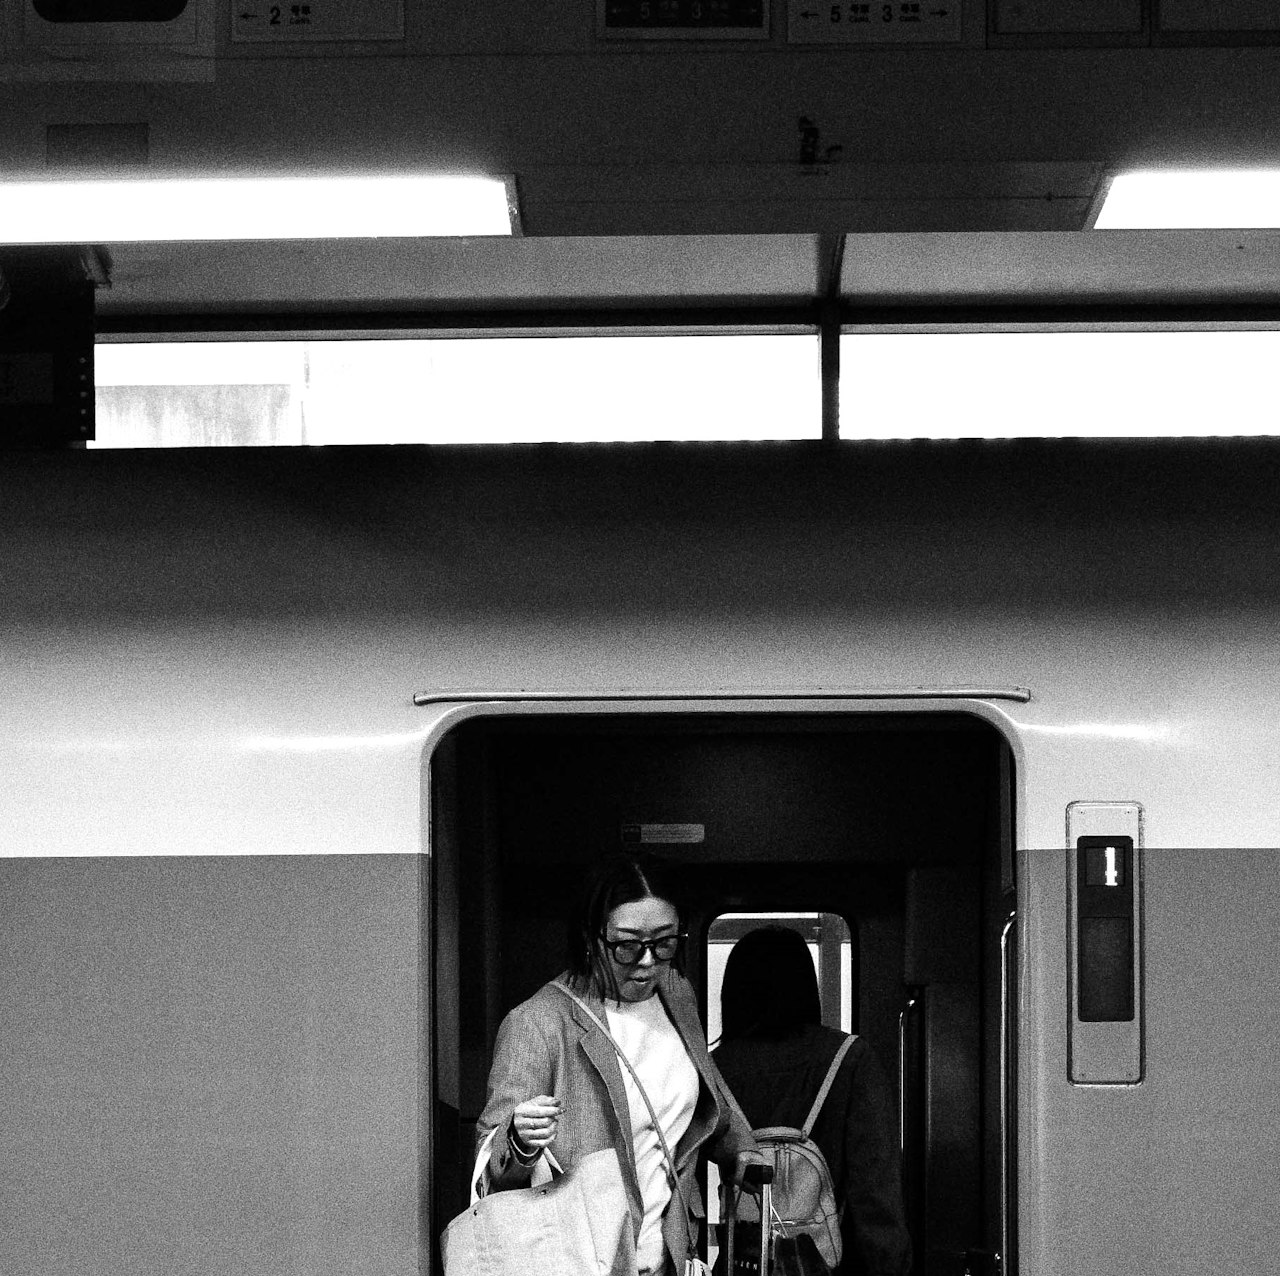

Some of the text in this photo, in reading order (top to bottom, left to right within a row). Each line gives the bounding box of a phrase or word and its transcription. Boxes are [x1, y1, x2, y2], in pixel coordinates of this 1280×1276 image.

[270, 6, 281, 25] 2
[830, 5, 841, 23] 5
[882, 5, 893, 23] 3
